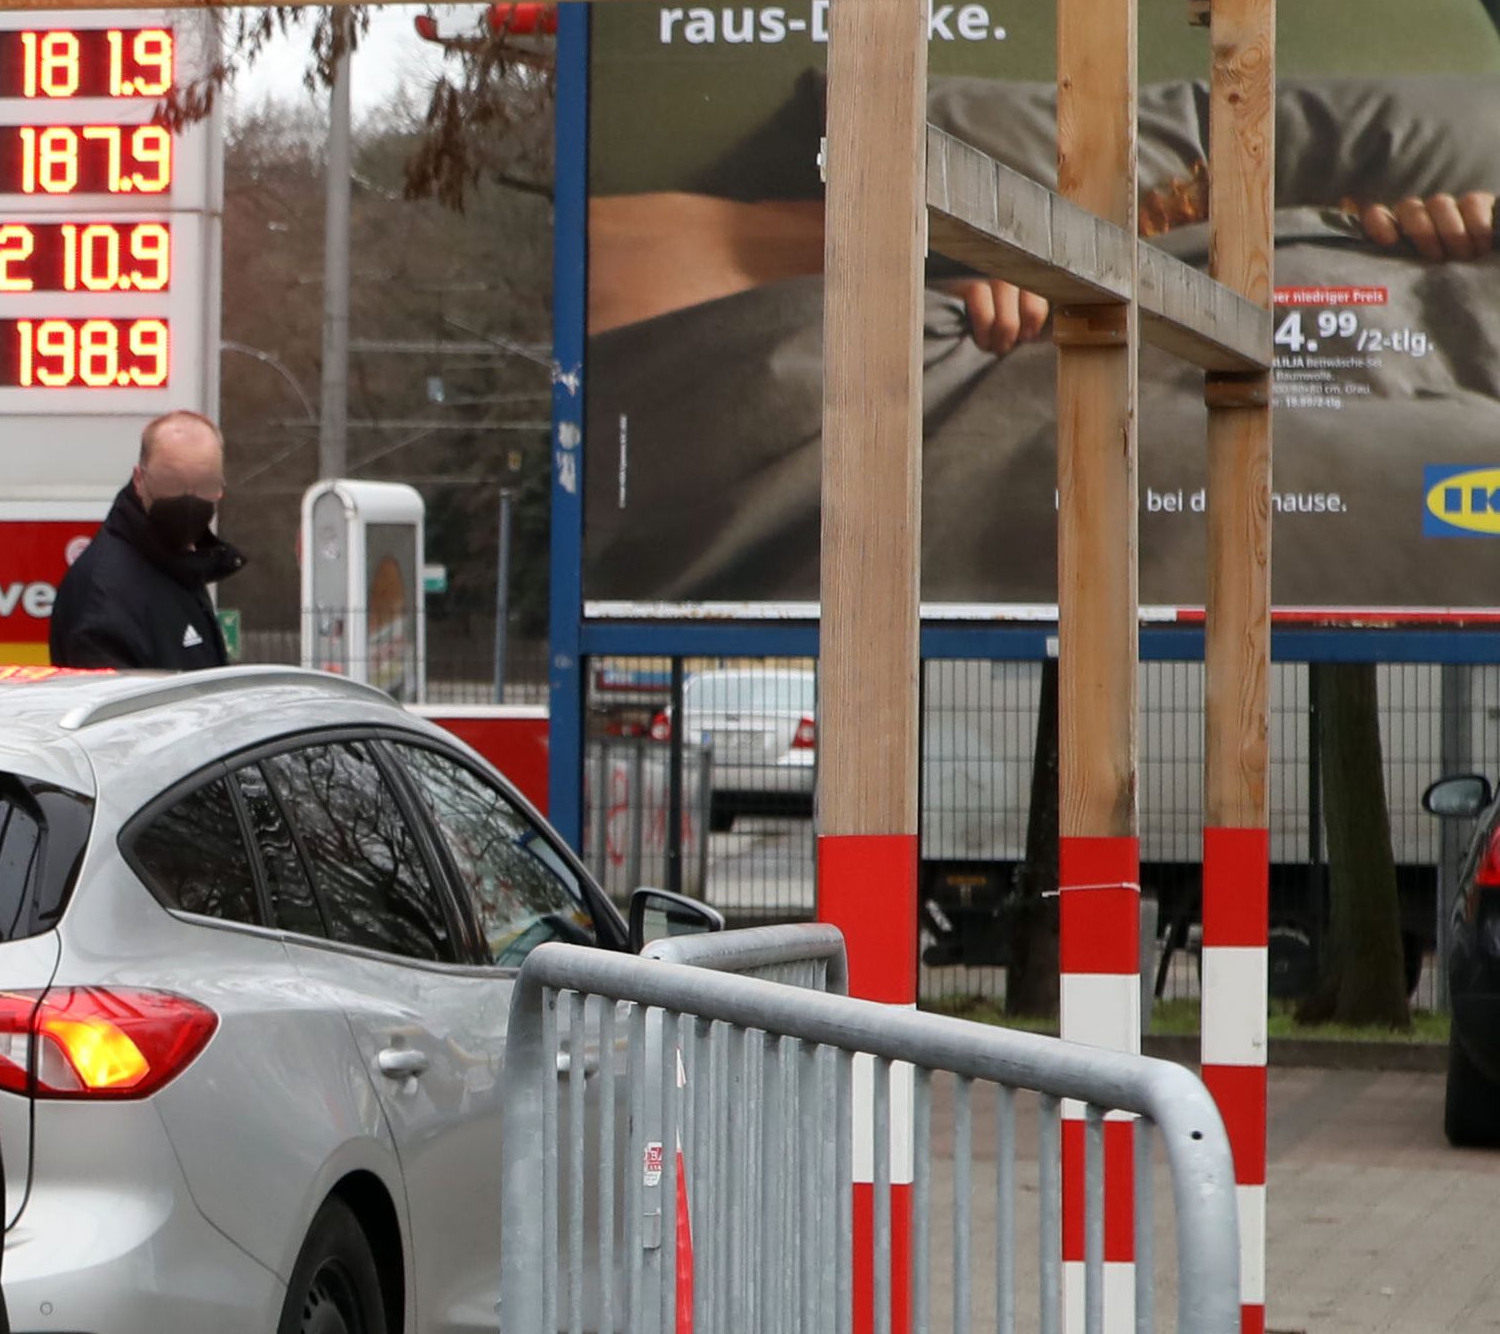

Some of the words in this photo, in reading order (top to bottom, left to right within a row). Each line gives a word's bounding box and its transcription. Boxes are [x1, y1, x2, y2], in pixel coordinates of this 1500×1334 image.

[19, 29, 173, 97] 181.9
[19, 125, 172, 193] 187.9
[17, 319, 169, 387] 198.9
[1146, 487, 1184, 513] bei
